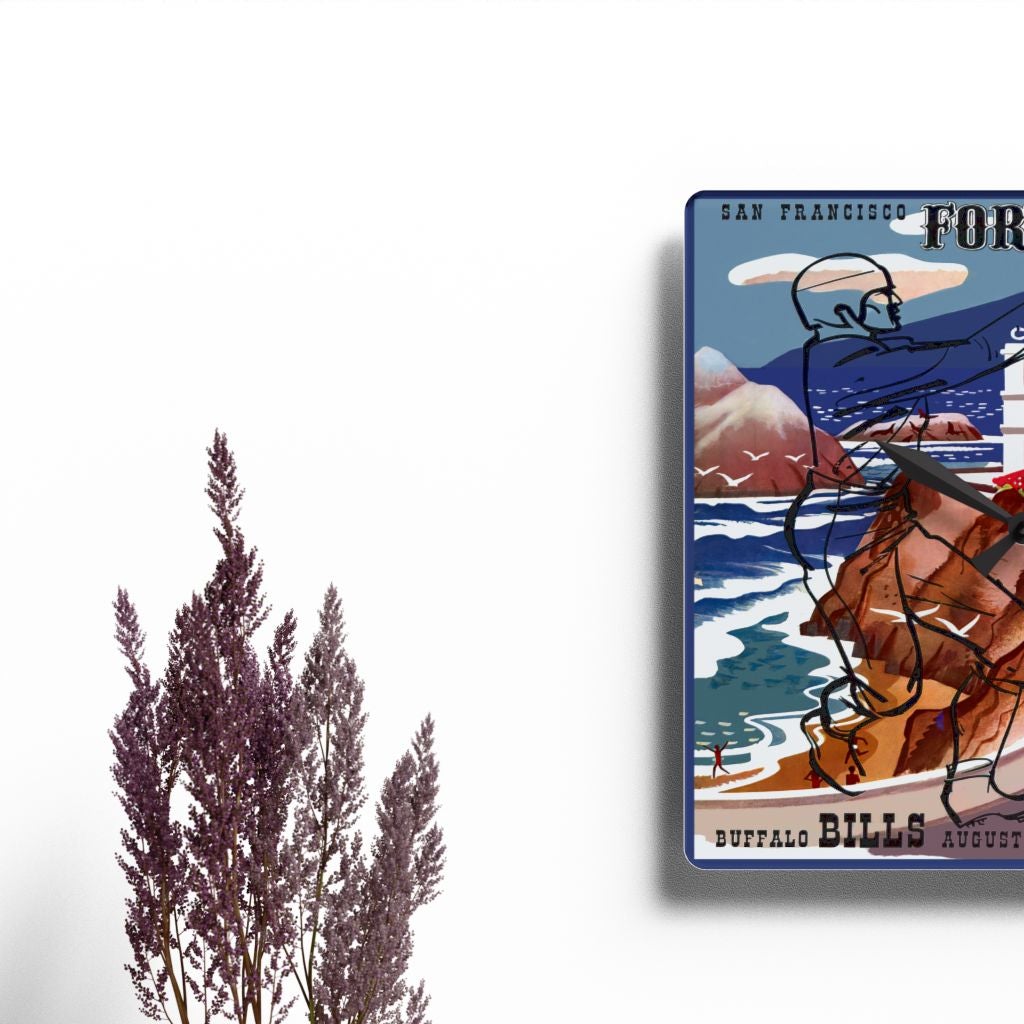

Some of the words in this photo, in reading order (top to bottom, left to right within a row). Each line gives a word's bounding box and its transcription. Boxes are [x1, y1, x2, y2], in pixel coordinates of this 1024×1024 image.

[721, 203, 763, 220] SAN
[780, 203, 906, 220] FRANCISCO
[715, 829, 808, 848] BUFFALO
[819, 812, 925, 849] BILLS
[941, 831, 1022, 849] AUGUST
